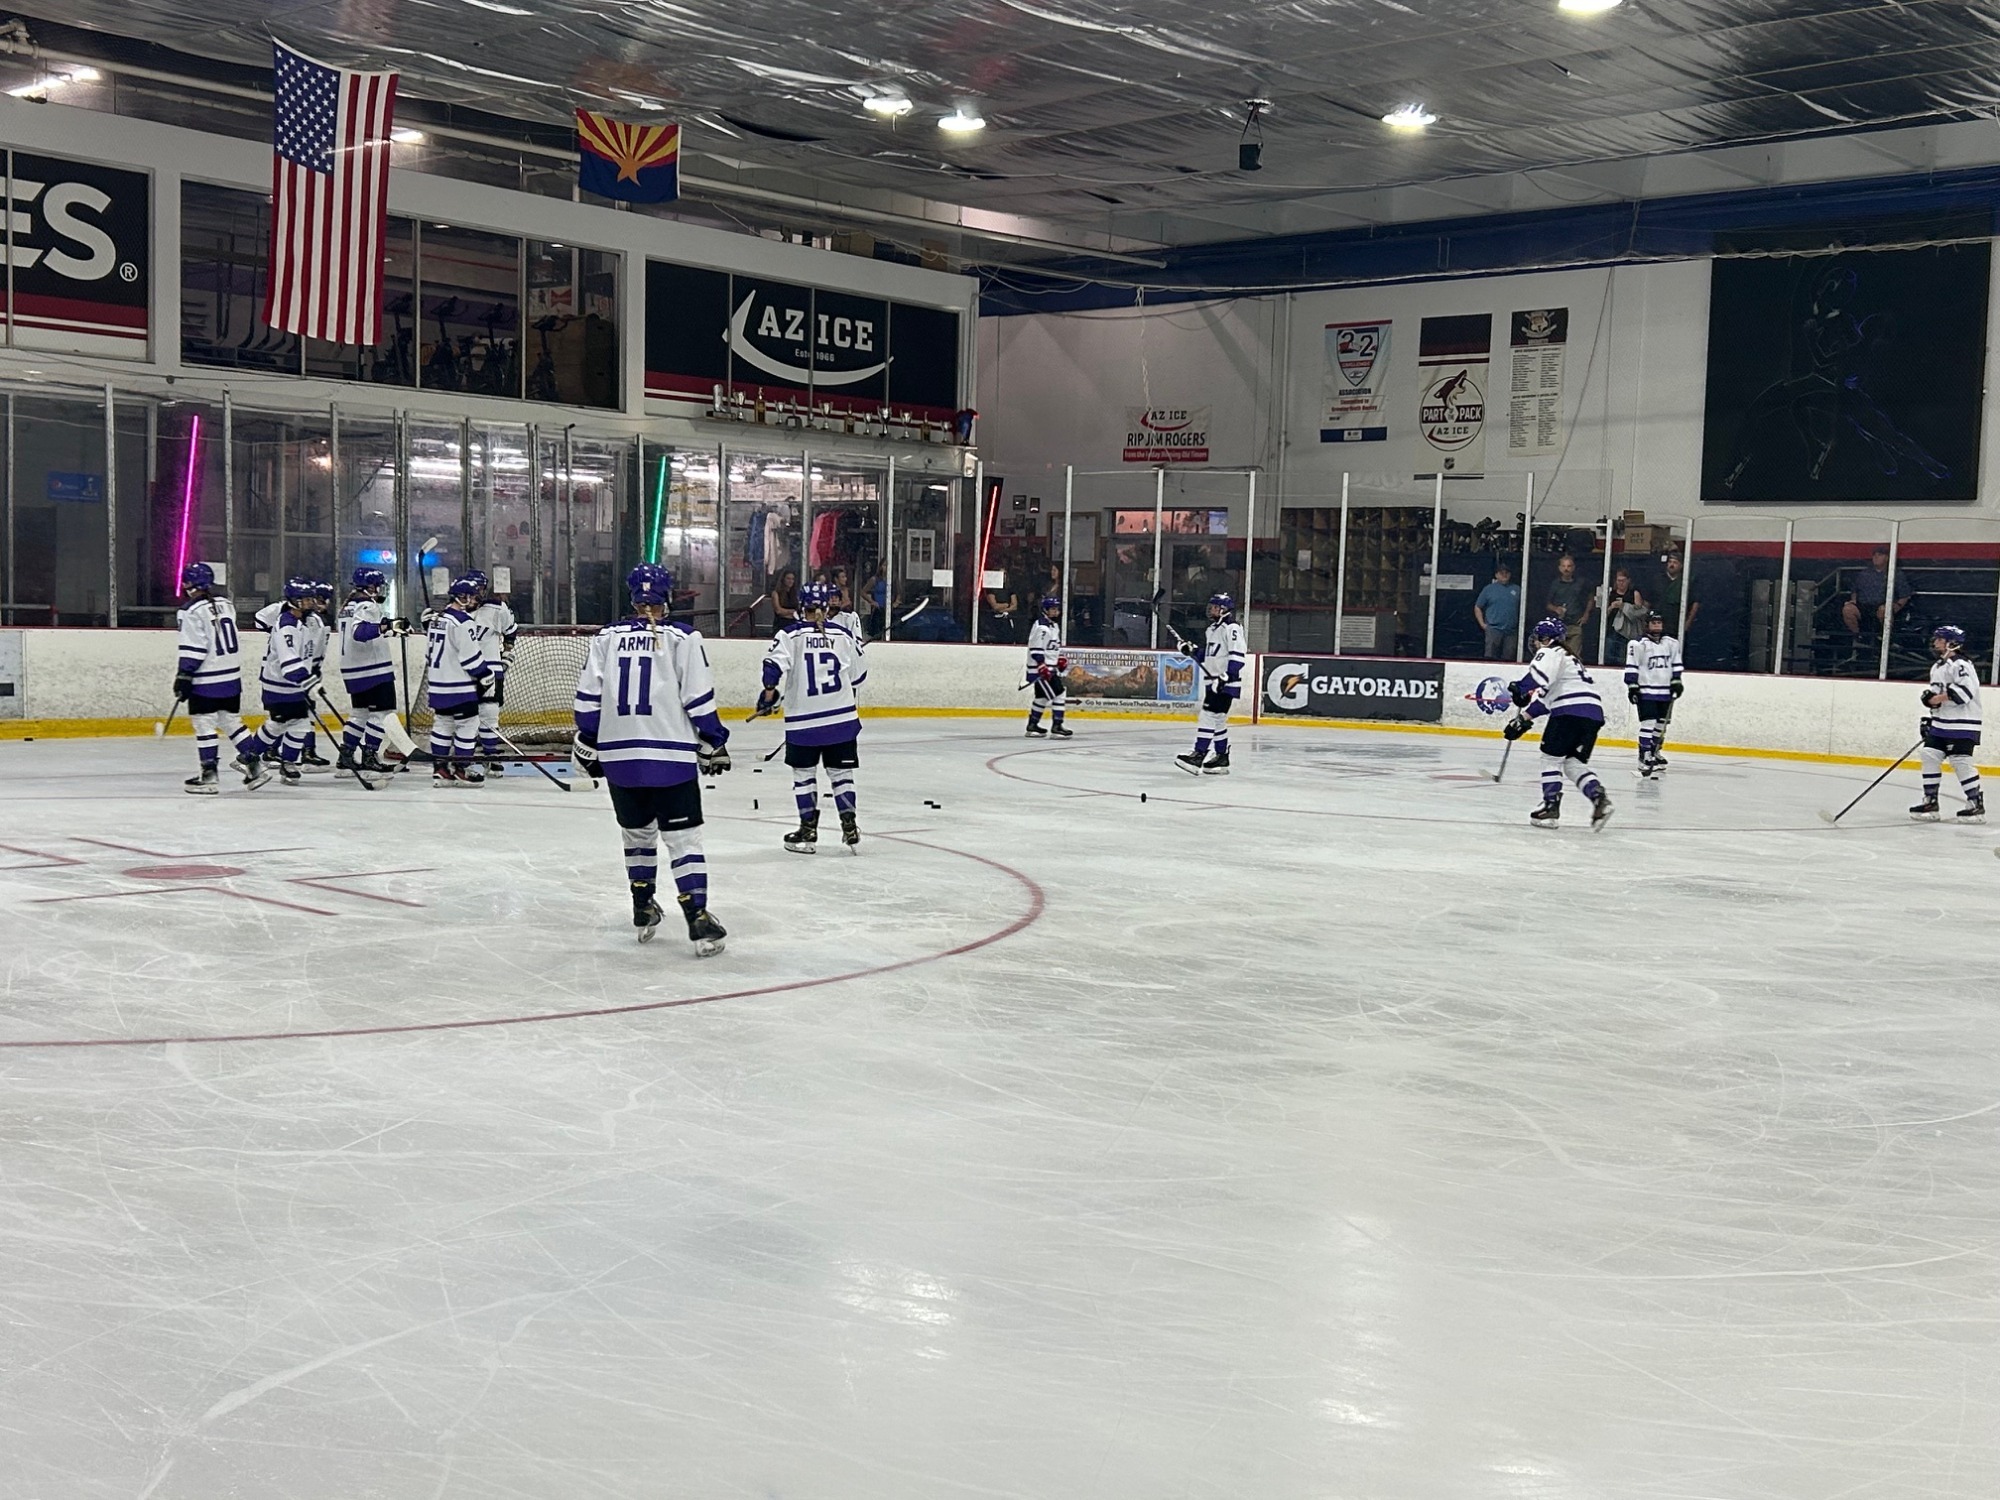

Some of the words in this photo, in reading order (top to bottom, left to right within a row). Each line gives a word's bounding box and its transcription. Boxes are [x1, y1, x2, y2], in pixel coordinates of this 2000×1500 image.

[758, 306, 804, 341] AZ
[818, 314, 873, 352] ICE
[1151, 411, 1165, 420] AZ
[1169, 410, 1187, 420] ICE
[1423, 408, 1444, 421] PART
[1459, 406, 1481, 420] PACK
[1127, 433, 1144, 446] RIP
[1165, 432, 1206, 446] ROGERS
[1437, 427, 1449, 435] AZ
[1452, 426, 1469, 435] ICE
[210, 617, 239, 656] 10
[617, 656, 652, 716] 11
[804, 652, 842, 697] 13
[1310, 675, 1439, 699] GATORADE
